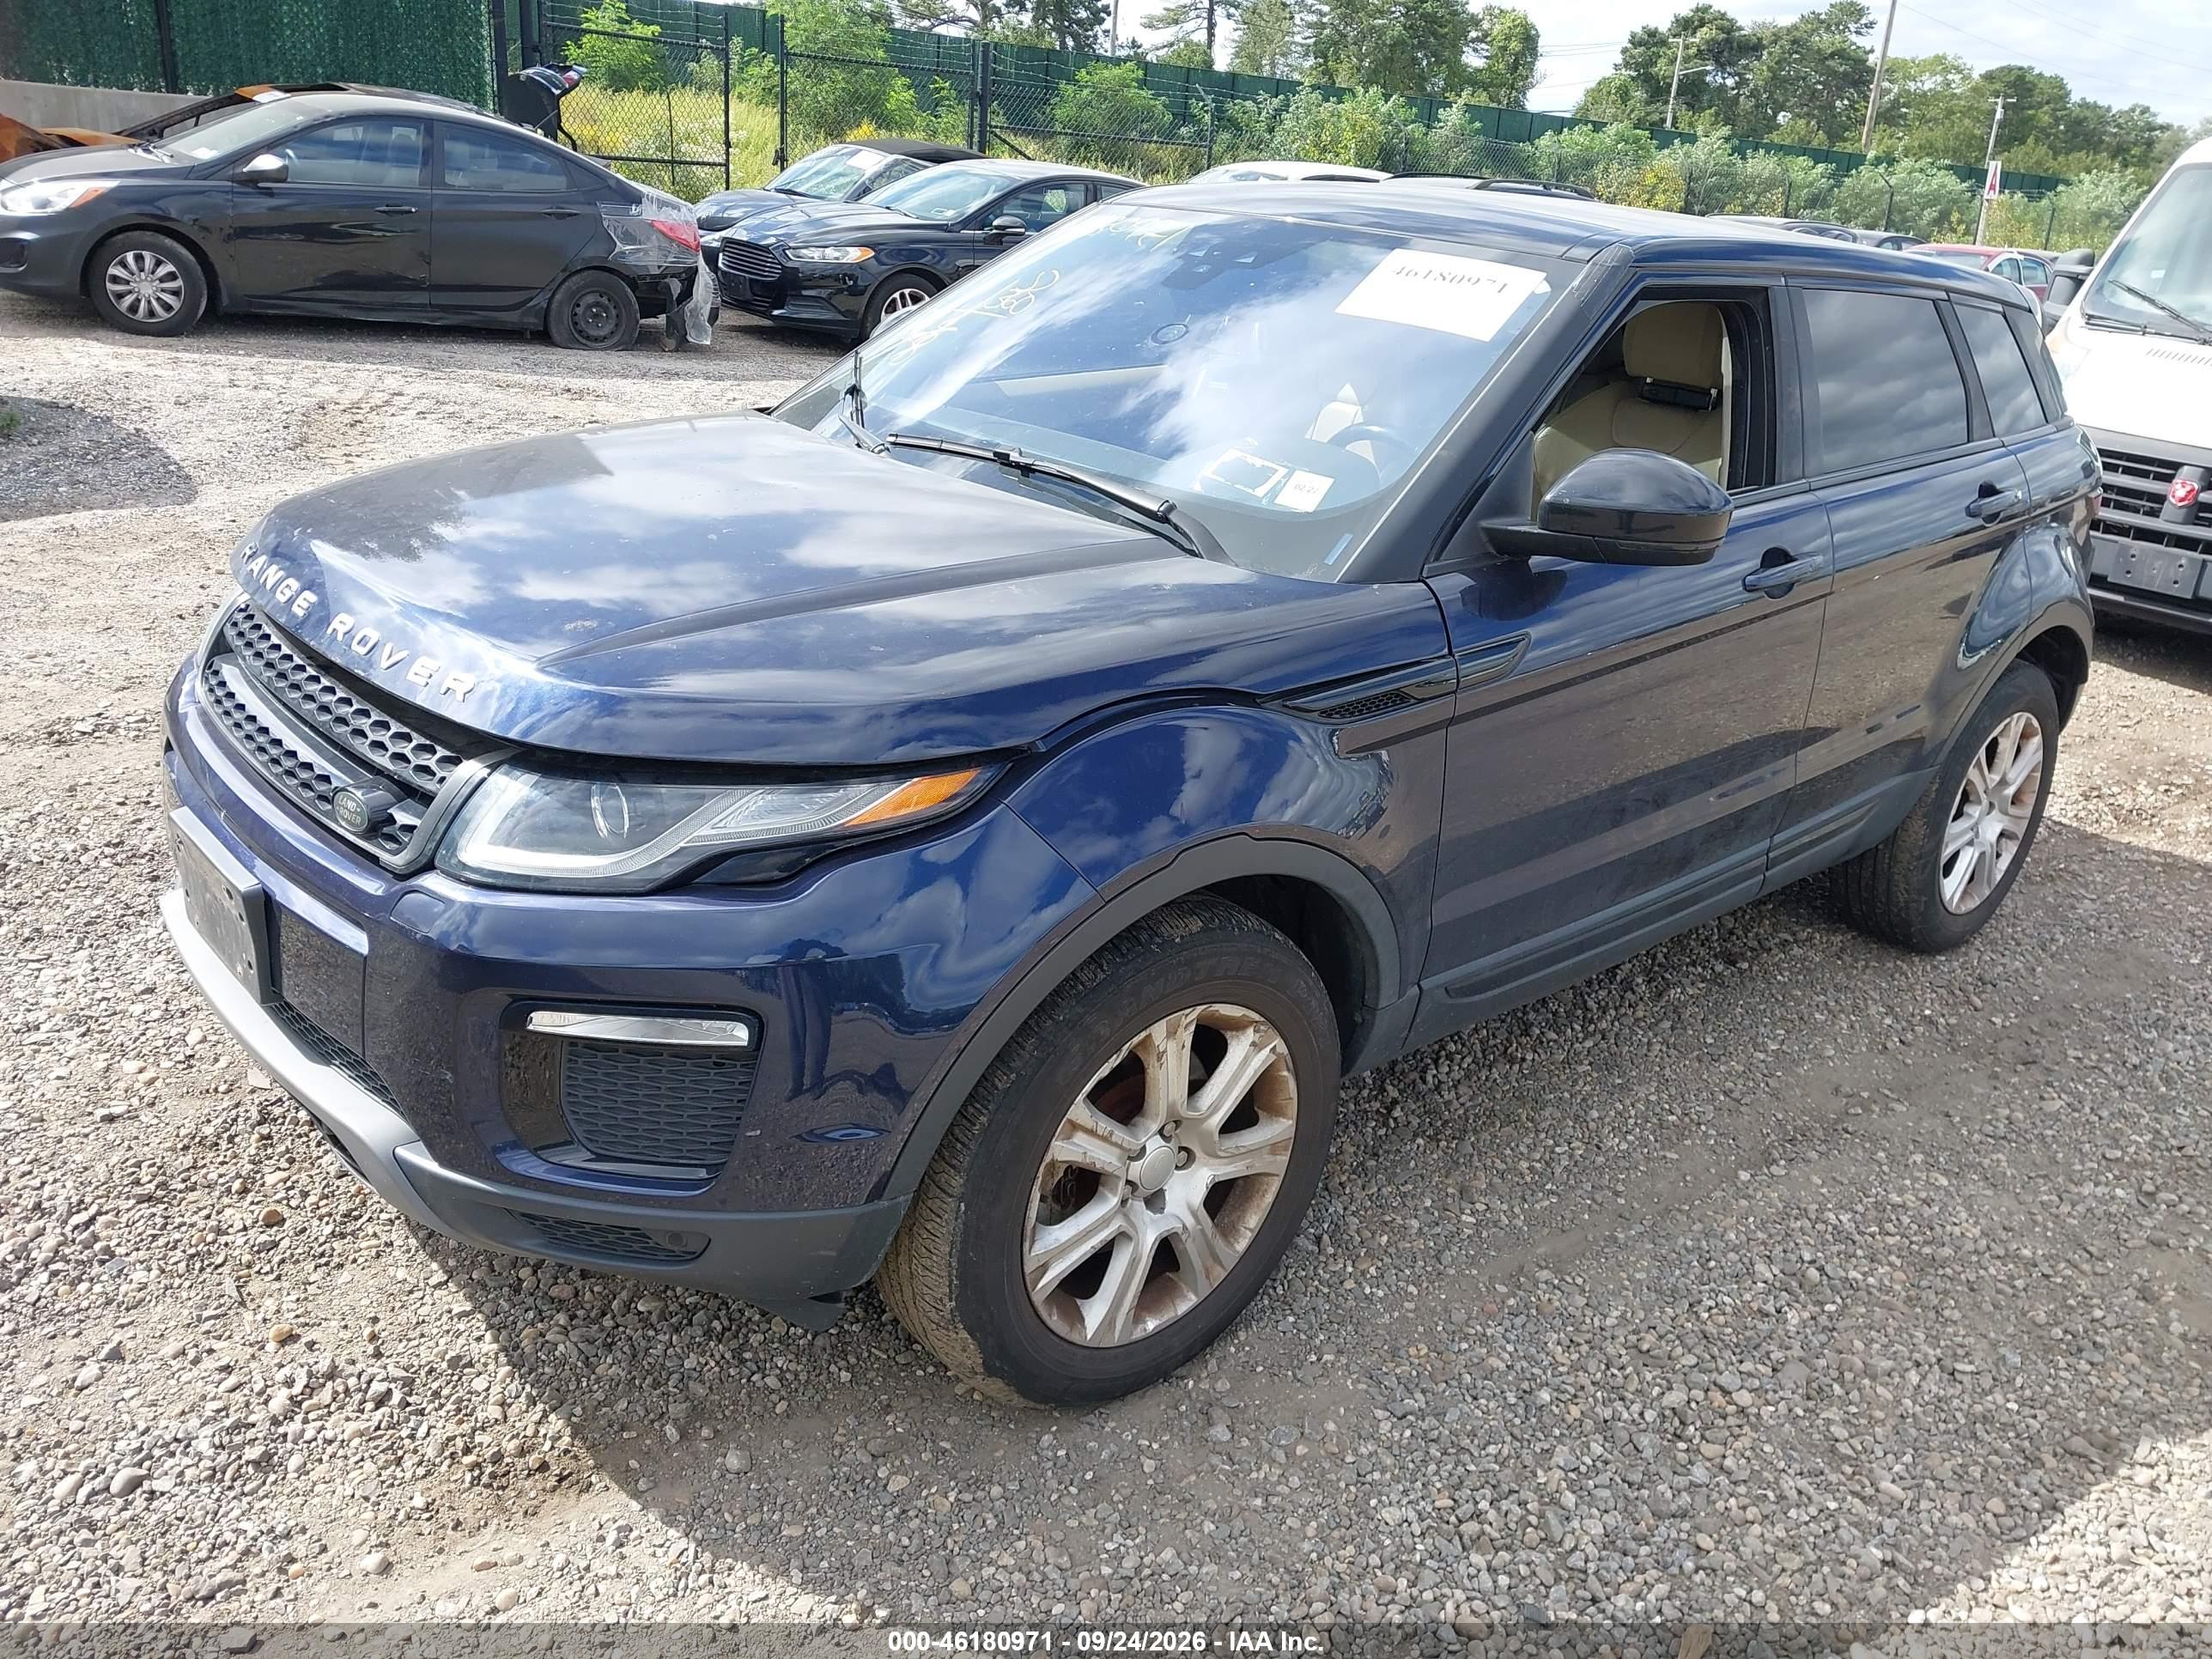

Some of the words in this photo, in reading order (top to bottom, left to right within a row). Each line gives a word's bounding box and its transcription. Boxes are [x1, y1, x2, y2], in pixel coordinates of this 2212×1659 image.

[1987, 162, 1998, 196] A
[1391, 264, 1510, 295] 46180971
[240, 540, 319, 619] RANGE
[325, 611, 477, 703] ROVER
[338, 794, 356, 811] LAND
[339, 808, 362, 825] ROVER
